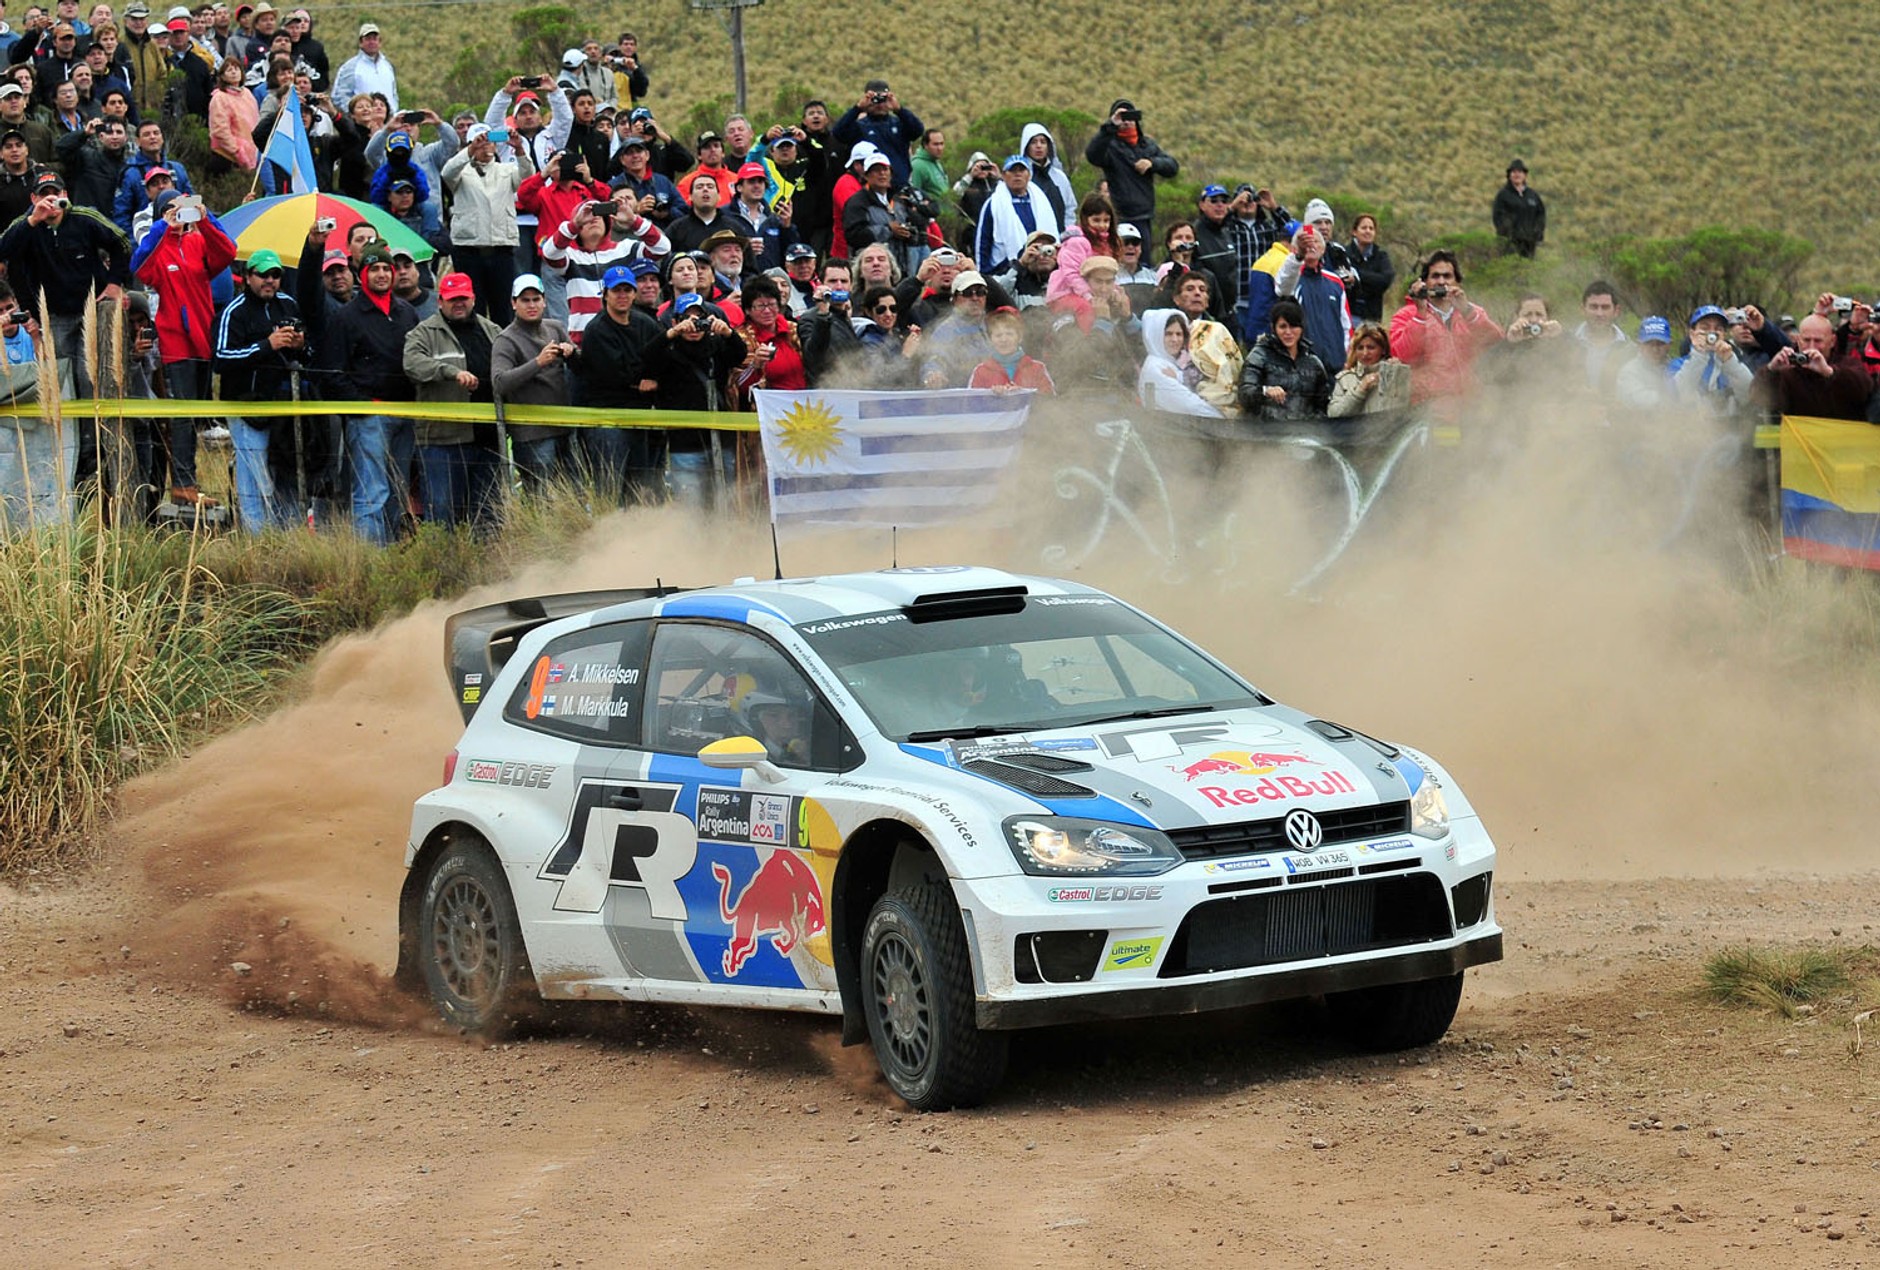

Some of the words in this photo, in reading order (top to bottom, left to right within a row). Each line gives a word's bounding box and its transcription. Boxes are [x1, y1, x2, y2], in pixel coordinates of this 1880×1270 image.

[802, 613, 908, 634] Volkswagen
[567, 664, 579, 683] A.
[582, 664, 639, 685] Mikkelsen
[526, 655, 552, 719] 9
[561, 696, 575, 716] M.
[577, 696, 629, 717] Markkula
[473, 763, 499, 780] Castrol
[499, 762, 559, 789] EDGE
[700, 792, 730, 805] PHILIPS
[1197, 778, 1286, 809] Red
[1276, 770, 1356, 798] Bull
[705, 806, 720, 818] Rally
[699, 814, 749, 837] Argentina
[752, 823, 773, 838] ACA
[798, 799, 810, 848] 9
[933, 801, 978, 848] Services
[536, 776, 699, 921] R
[1292, 857, 1314, 868] WOB
[1315, 855, 1329, 865] VW
[1329, 853, 1349, 863] 365
[1059, 889, 1091, 900] Castrol
[1093, 885, 1164, 901] EDGE
[1111, 944, 1151, 956] ultimate
